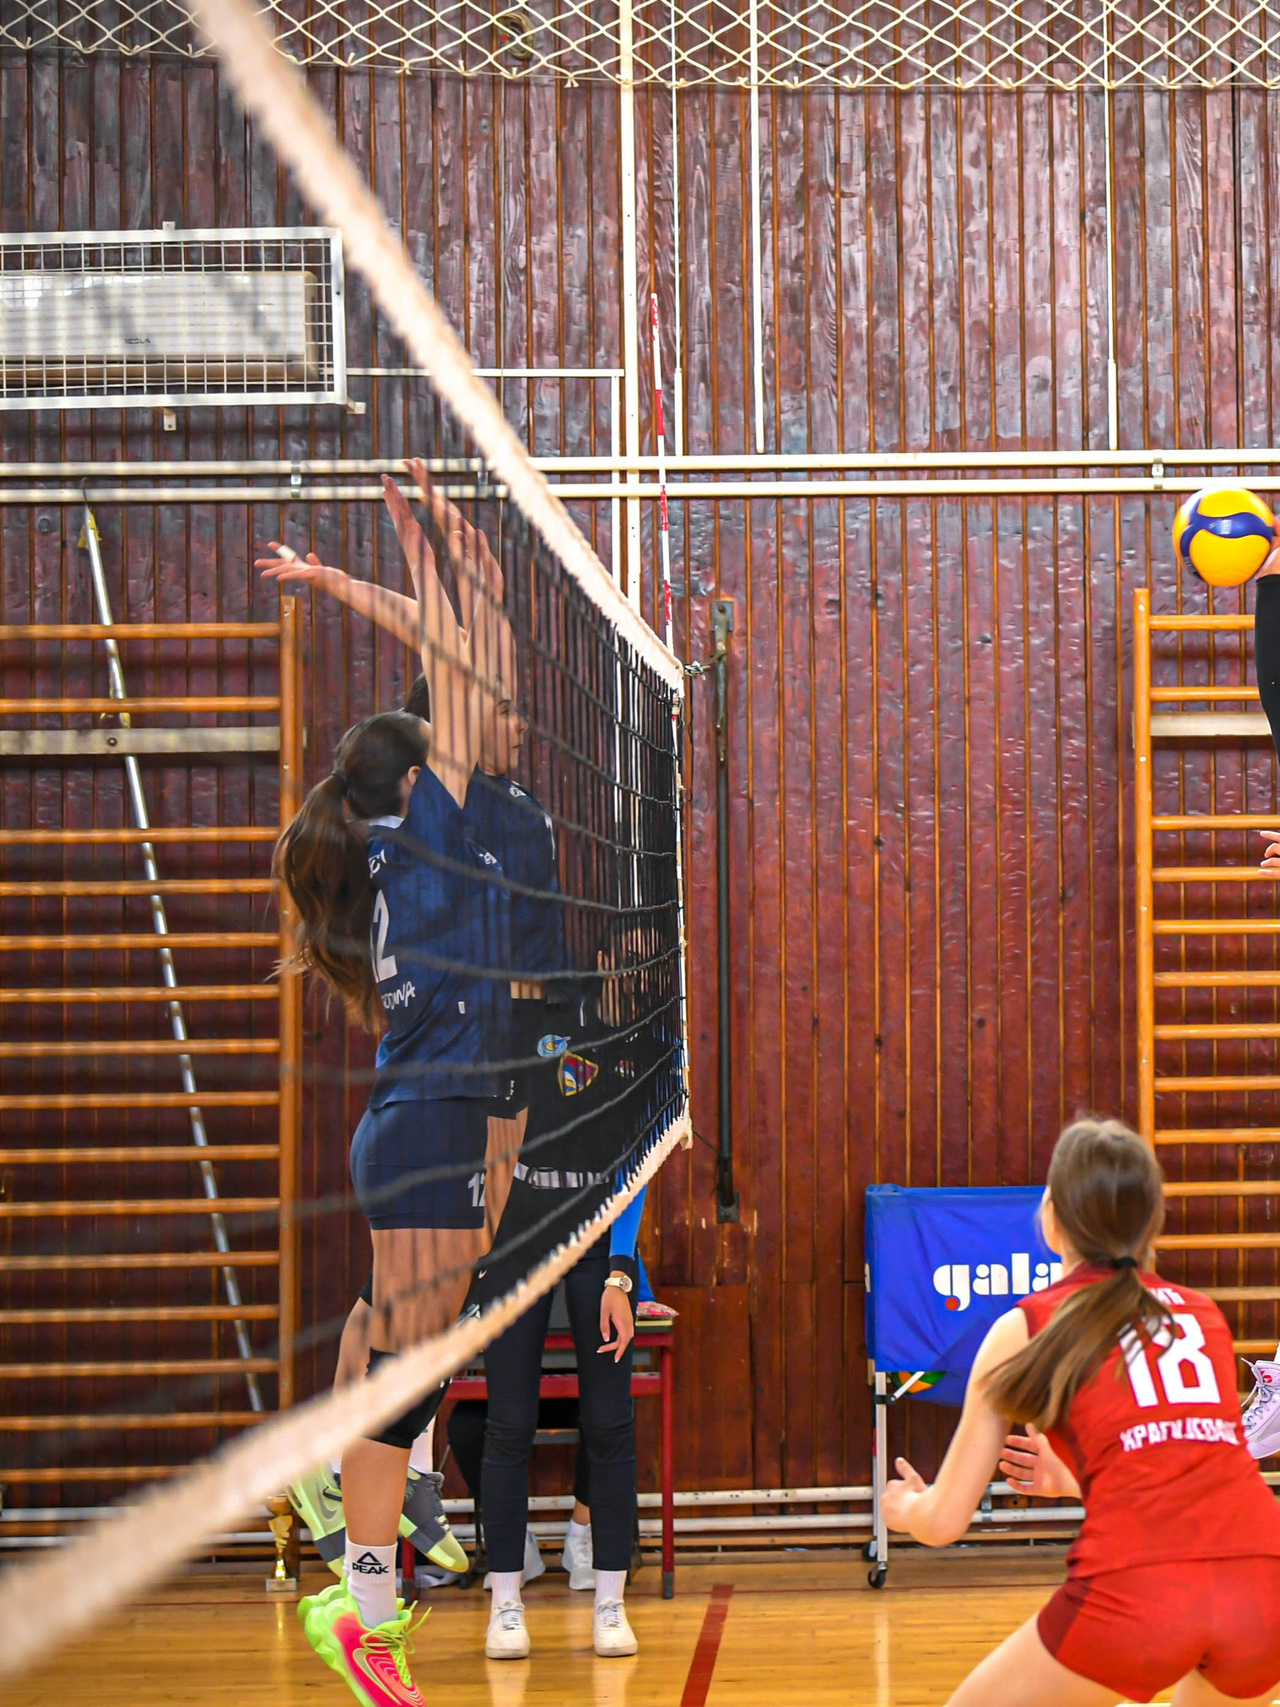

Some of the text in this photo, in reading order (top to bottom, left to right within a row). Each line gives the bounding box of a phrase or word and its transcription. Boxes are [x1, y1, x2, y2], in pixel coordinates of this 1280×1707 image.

[370, 889, 398, 984] 2
[1117, 1314, 1221, 1408] 18
[352, 1562, 389, 1574] PEAK
